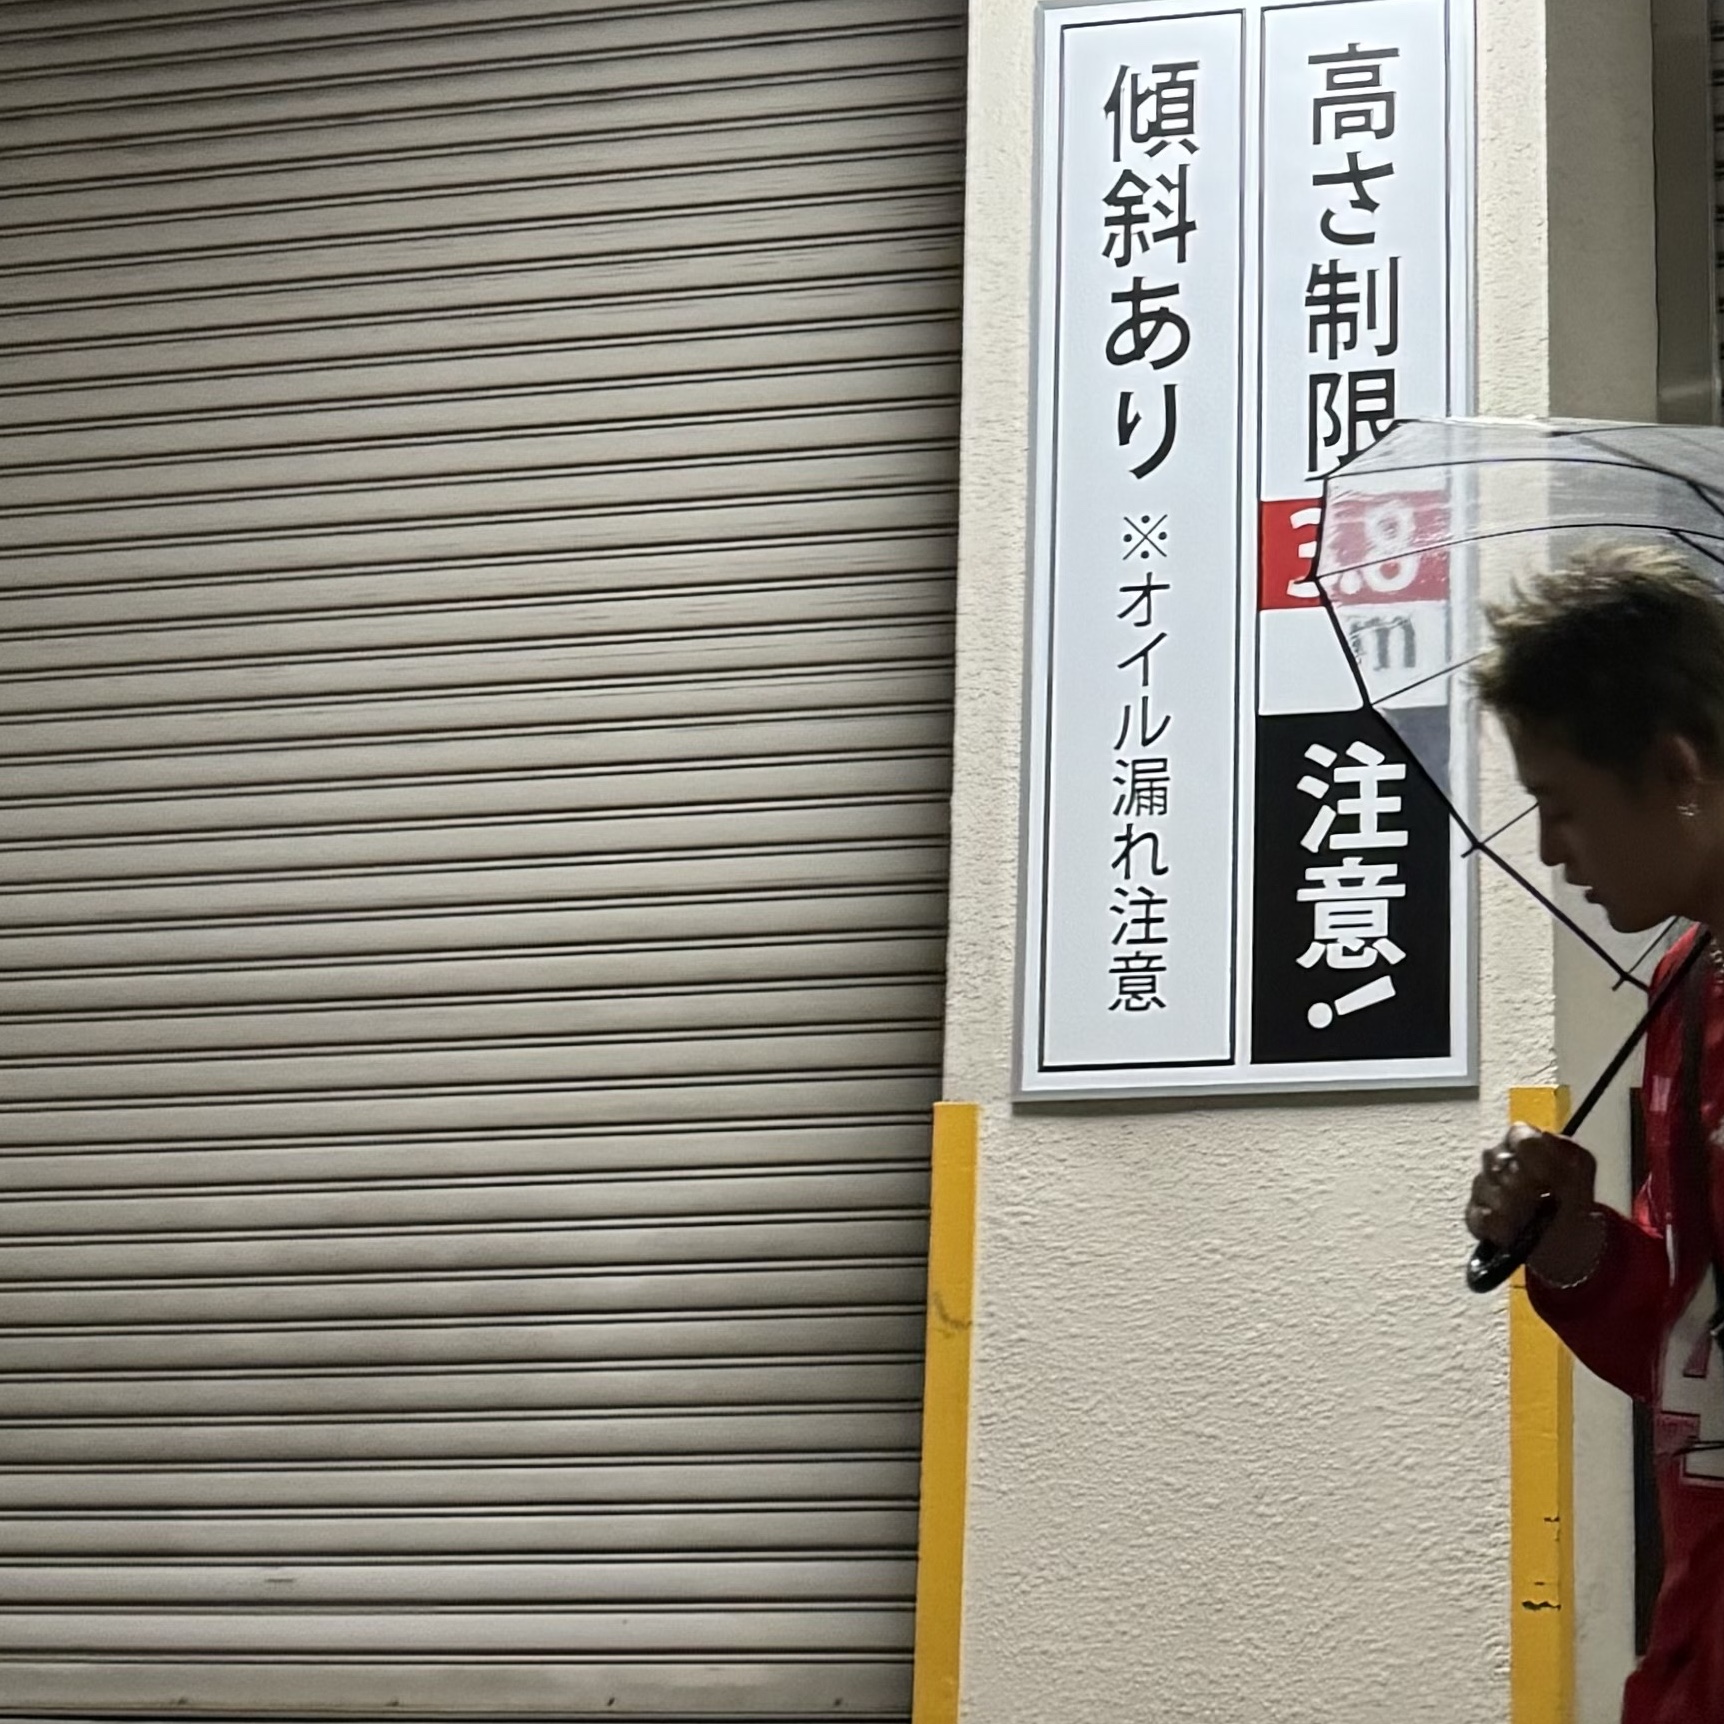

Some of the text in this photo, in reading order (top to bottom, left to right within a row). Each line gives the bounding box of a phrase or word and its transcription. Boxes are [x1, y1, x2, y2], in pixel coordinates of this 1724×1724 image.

[1102, 60, 1200, 480] 傾斜あり
[1305, 42, 1400, 474] 高さ制限
